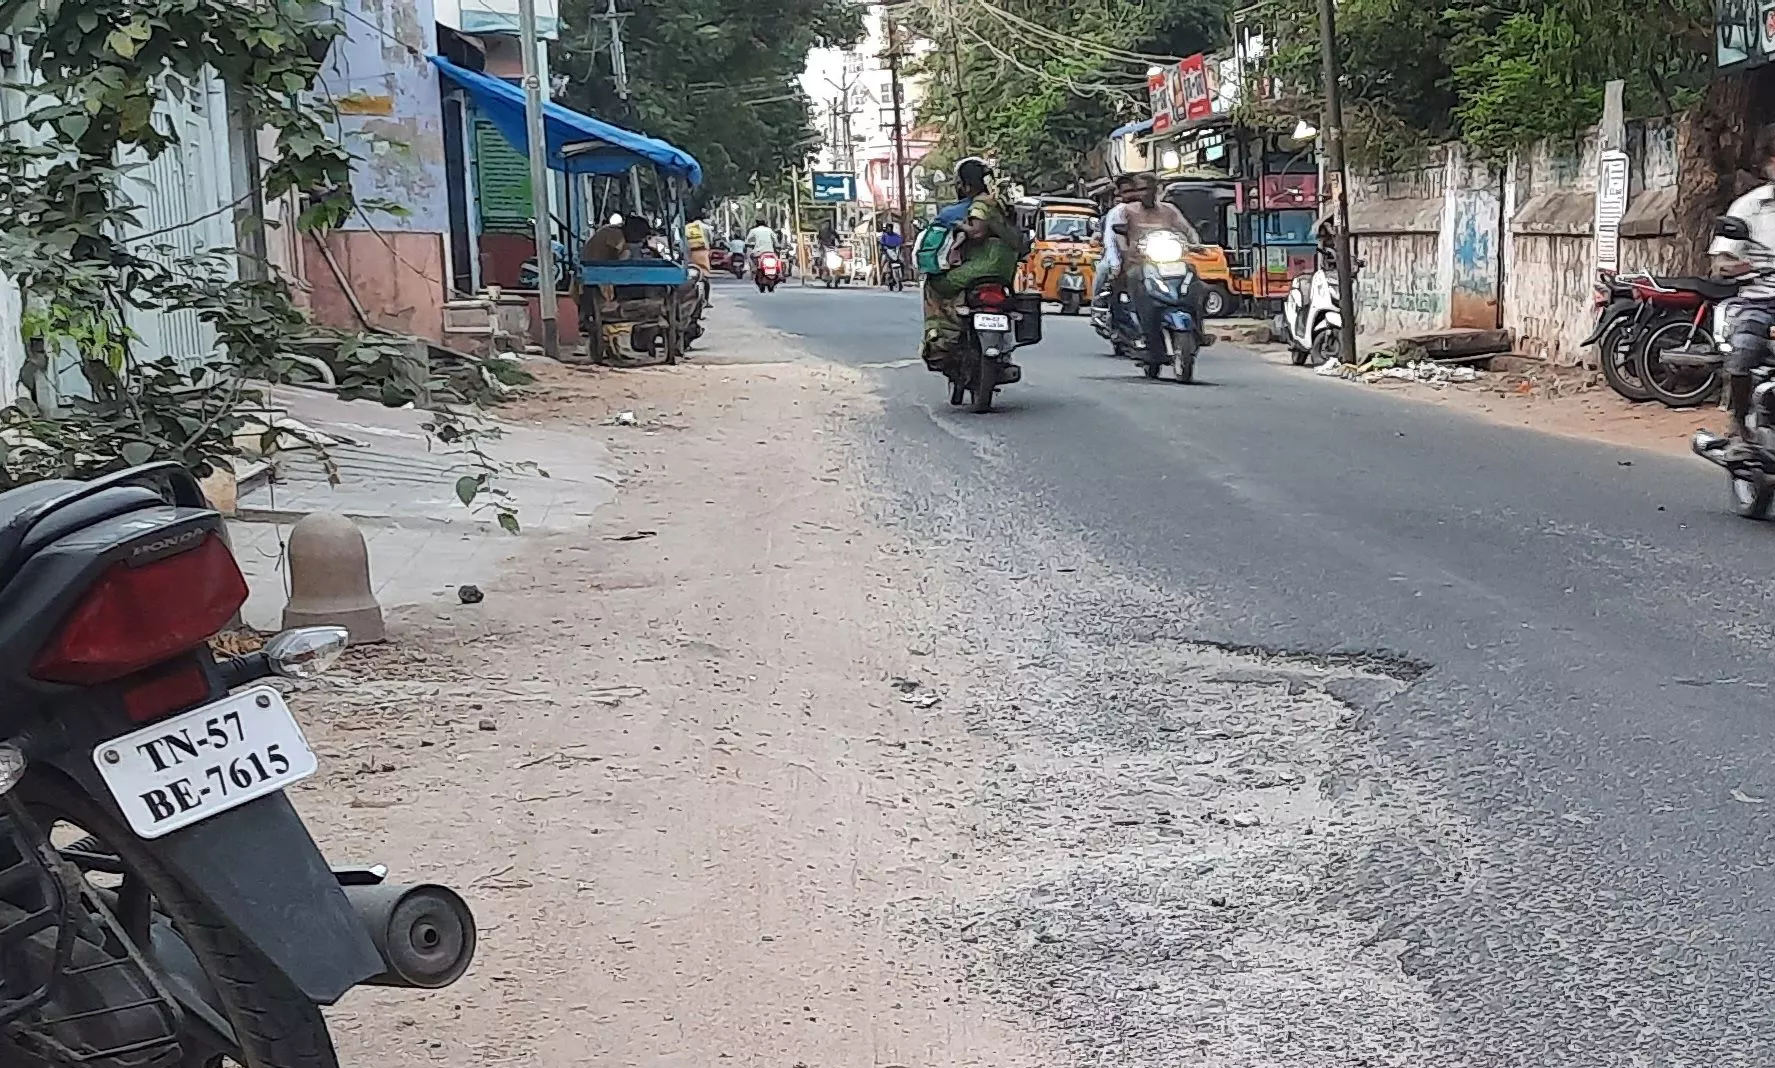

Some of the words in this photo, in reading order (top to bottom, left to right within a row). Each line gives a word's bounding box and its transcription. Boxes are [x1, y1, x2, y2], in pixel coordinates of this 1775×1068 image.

[132, 527, 205, 557] HONDA
[136, 711, 246, 773] TN-57
[139, 743, 291, 824] BE-7615
